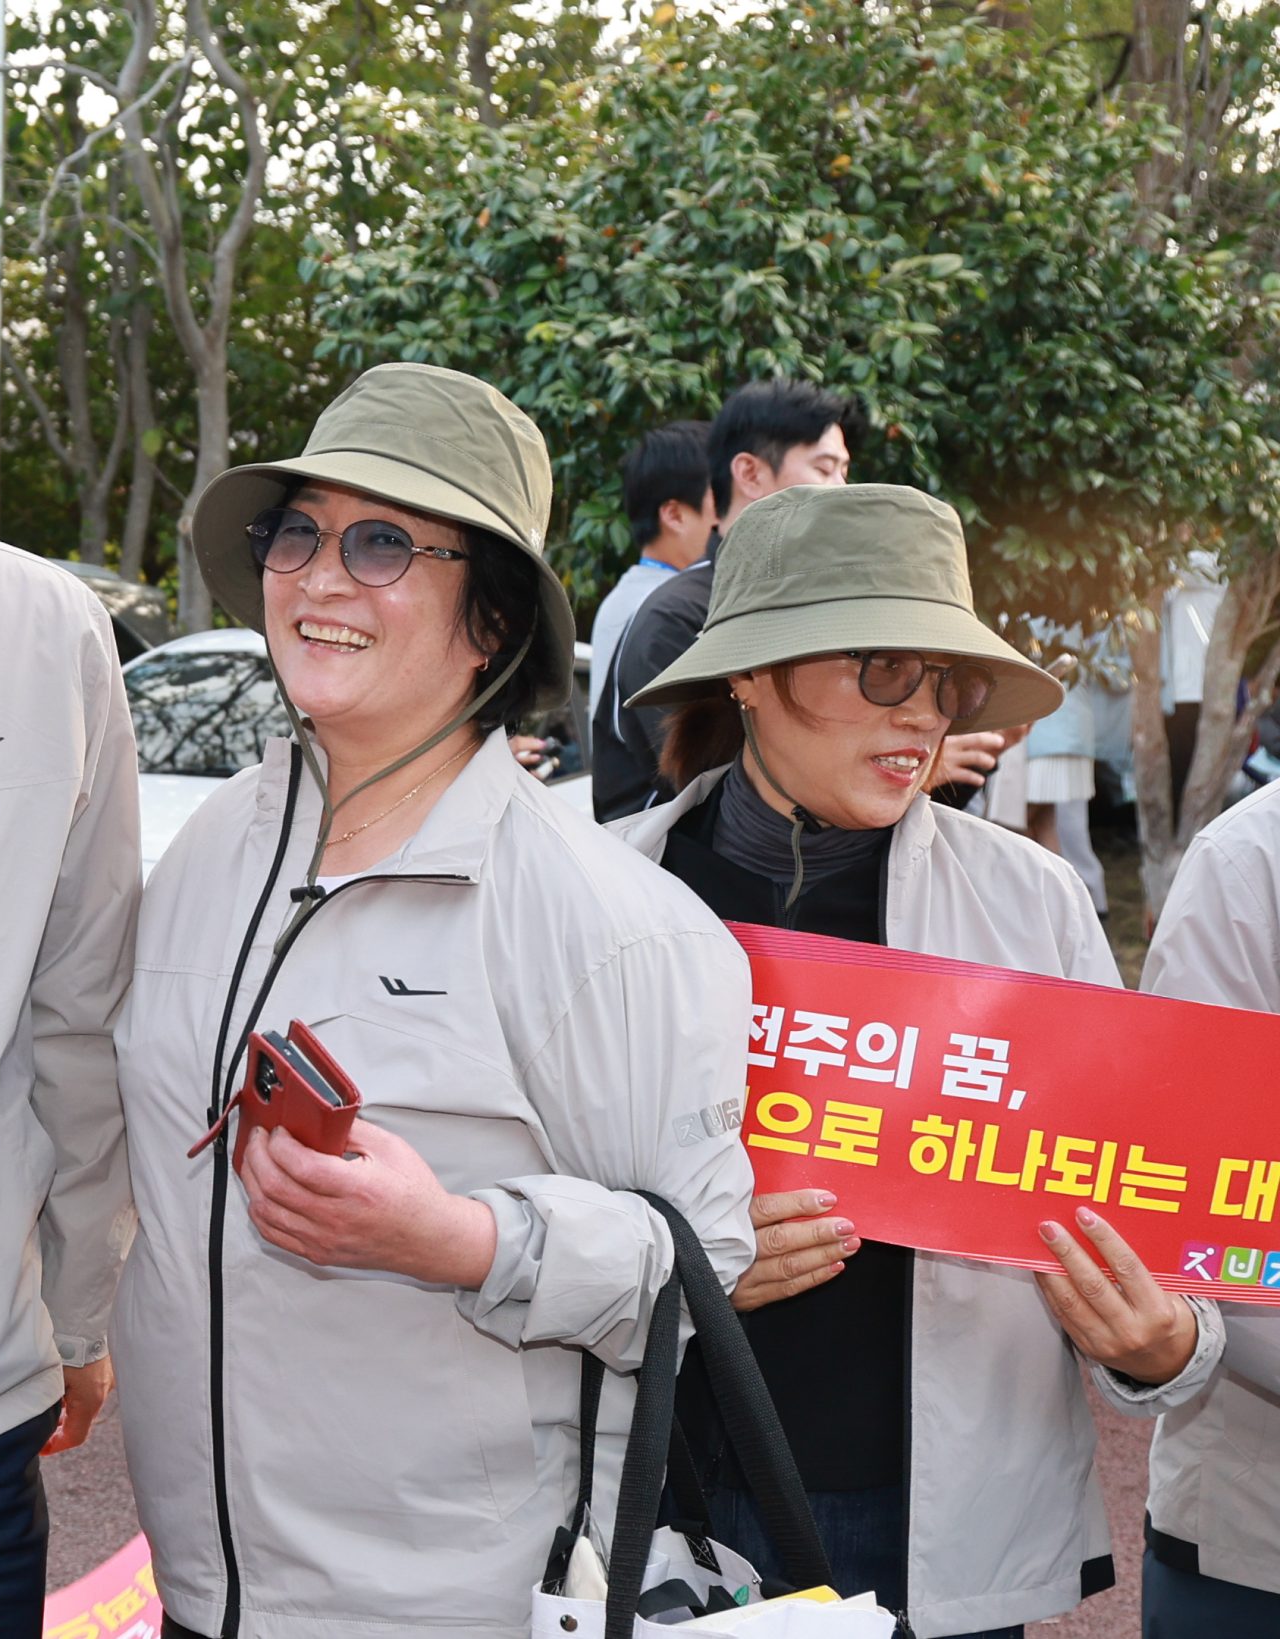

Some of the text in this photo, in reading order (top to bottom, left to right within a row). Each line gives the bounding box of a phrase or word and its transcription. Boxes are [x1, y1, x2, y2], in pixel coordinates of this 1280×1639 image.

[746, 1003, 1027, 1111] 전주의 꿈,
[742, 1086, 883, 1167] 으로
[909, 1114, 1188, 1213] 하나되는
